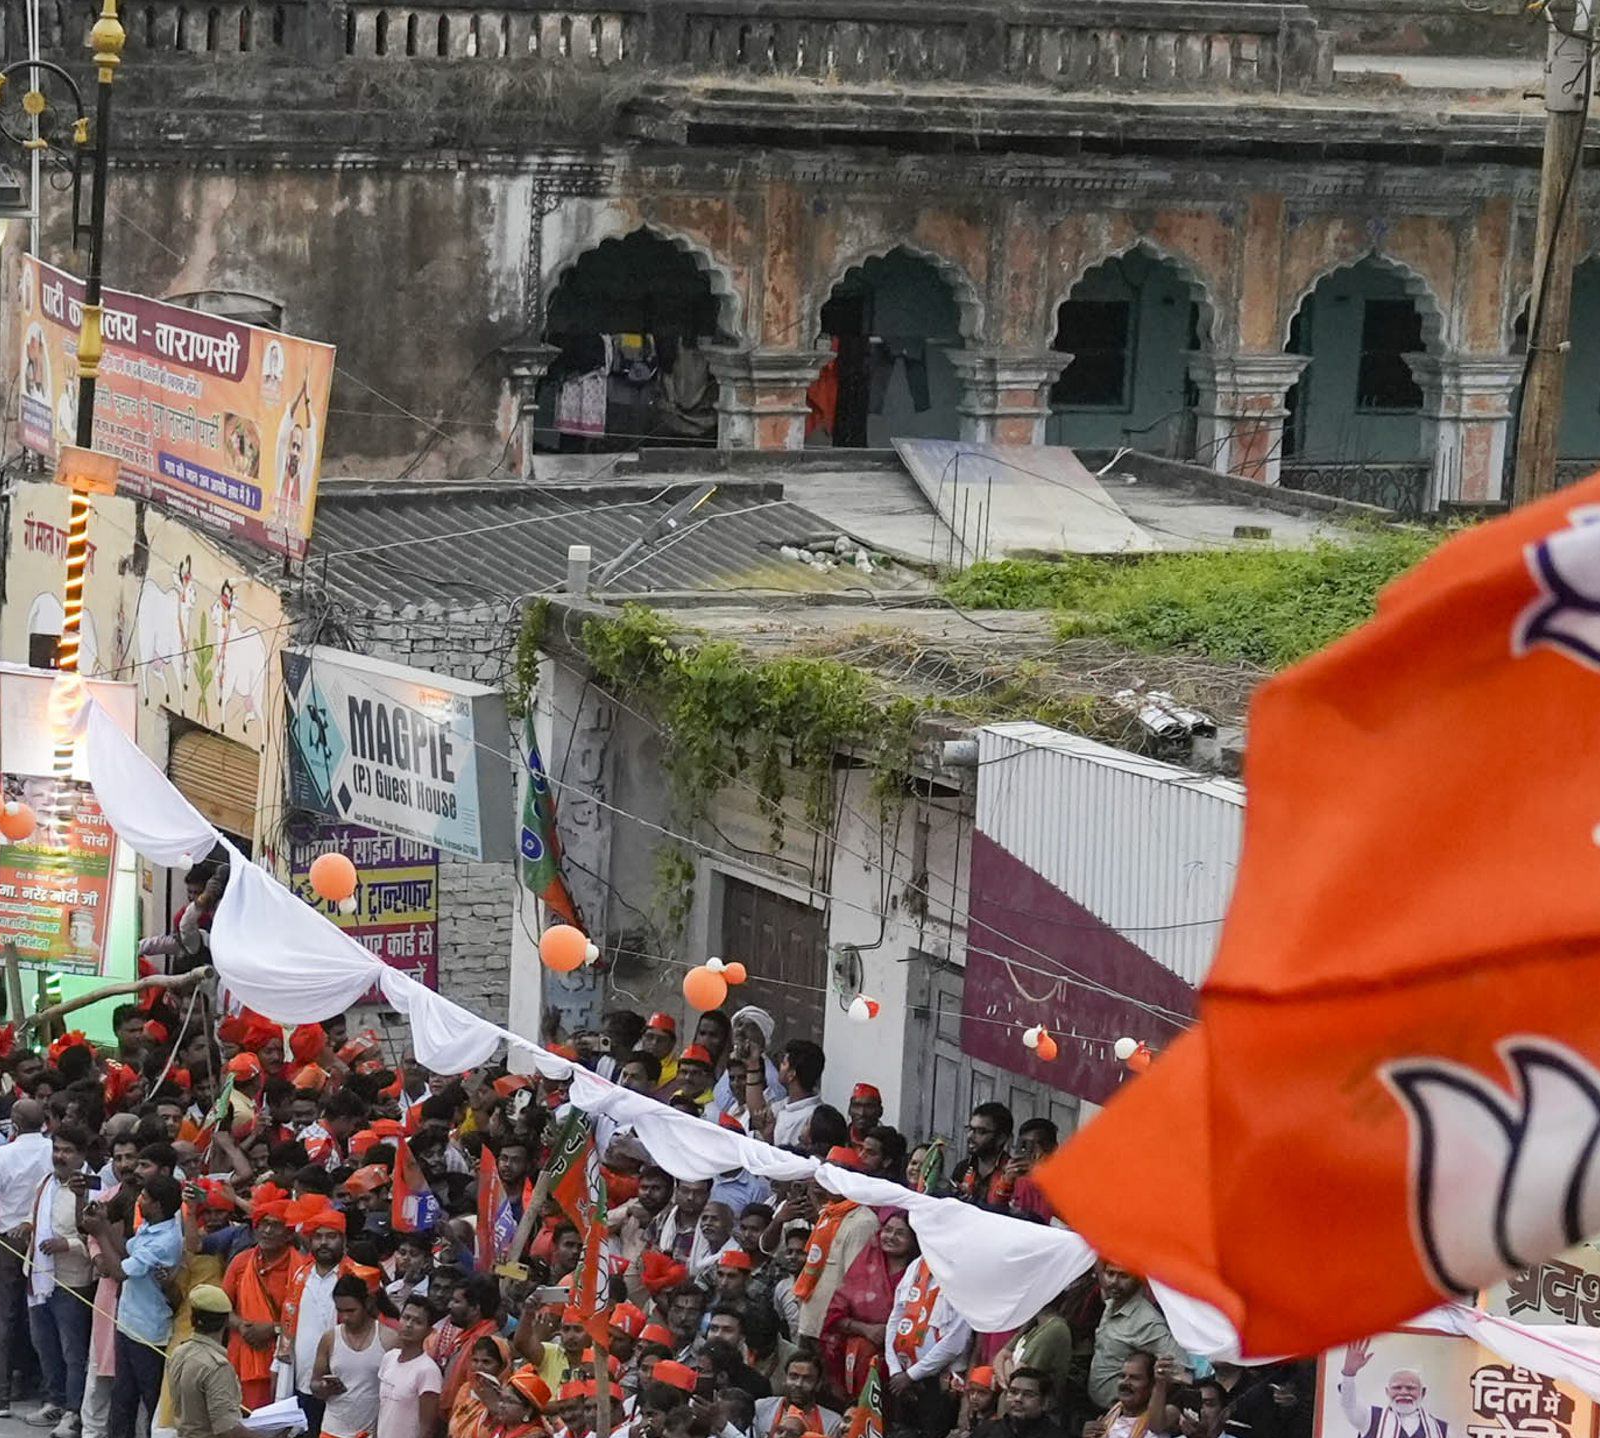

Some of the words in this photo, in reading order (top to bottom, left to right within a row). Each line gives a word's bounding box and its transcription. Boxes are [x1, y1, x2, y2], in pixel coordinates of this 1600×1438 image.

[154, 321, 242, 375] वाराणसी
[347, 694, 456, 784] MAGPIE
[375, 768, 413, 808] Guest
[415, 779, 458, 820] House
[1469, 1369, 1544, 1416] दिल
[1542, 1392, 1562, 1416] में
